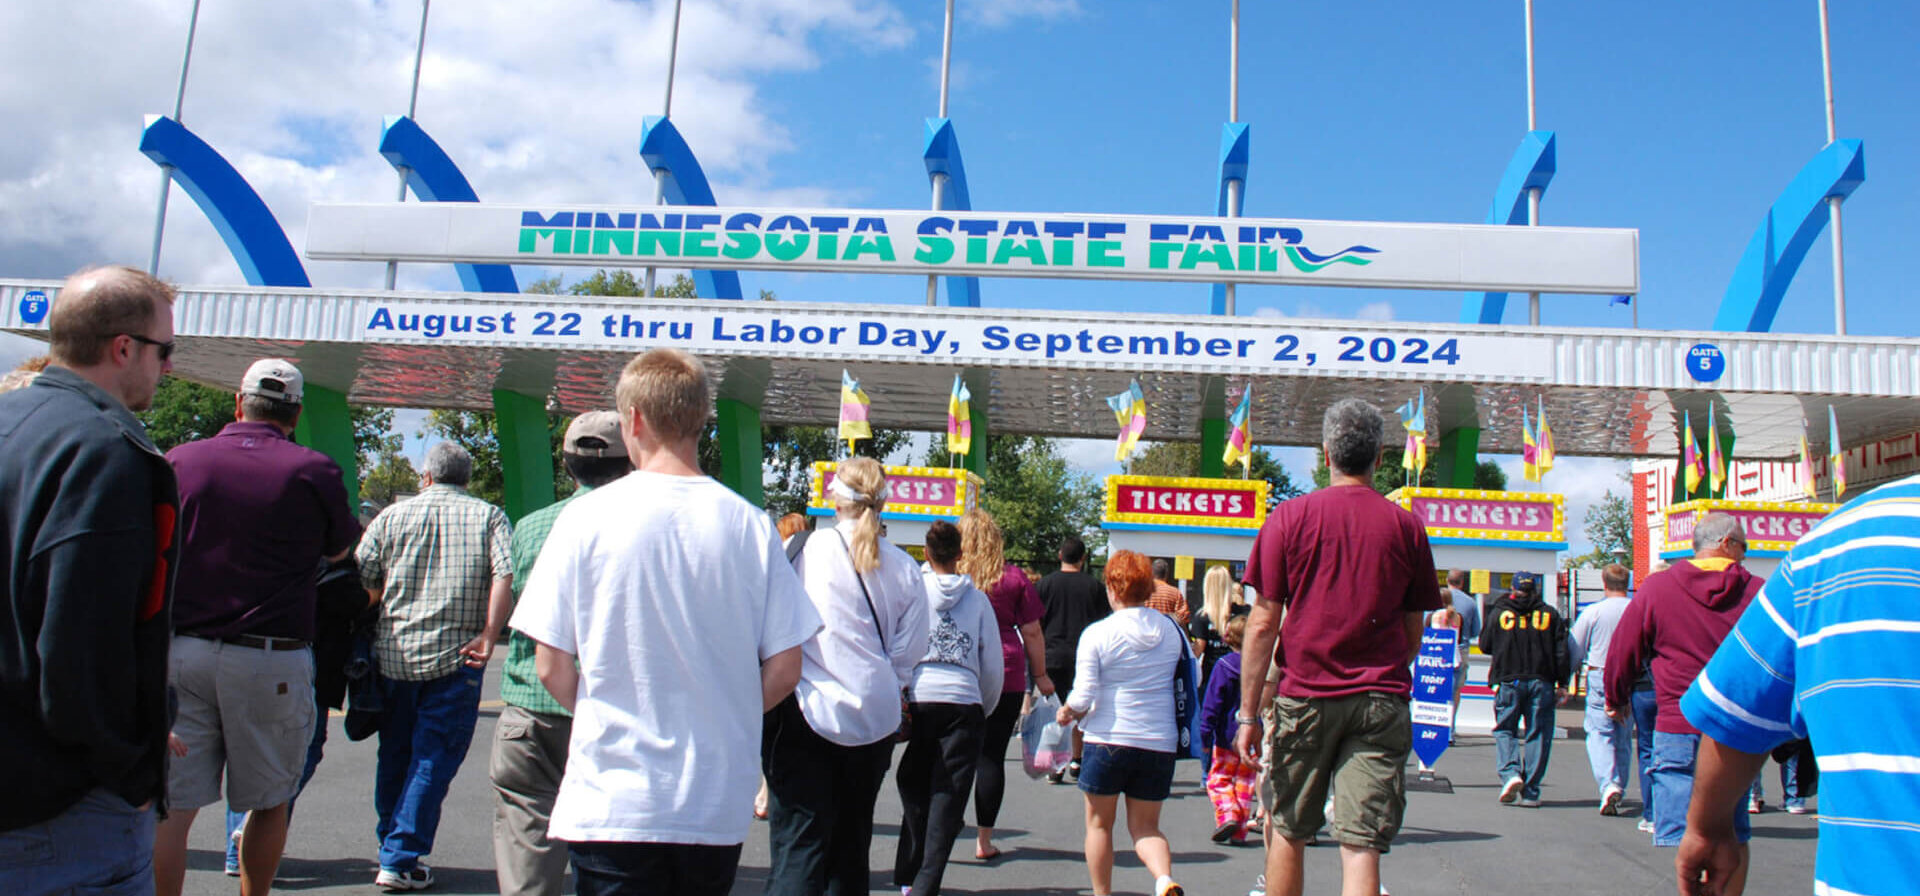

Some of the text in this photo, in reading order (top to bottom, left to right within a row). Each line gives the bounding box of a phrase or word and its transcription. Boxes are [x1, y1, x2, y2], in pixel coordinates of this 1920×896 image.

[518, 211, 1320, 272] MINNESOTA STATE FAIR
[25, 294, 46, 302] GATE
[29, 302, 38, 313] 5
[367, 307, 1460, 366] August 22 thru Labor Day, September 2, 2024
[1691, 348, 1720, 357] GATE
[1700, 357, 1711, 370] 5
[1131, 490, 1242, 514] TICKETS
[1426, 503, 1539, 527] TICKETS
[1420, 675, 1446, 685] TODAY
[1421, 730, 1438, 739] DAY
